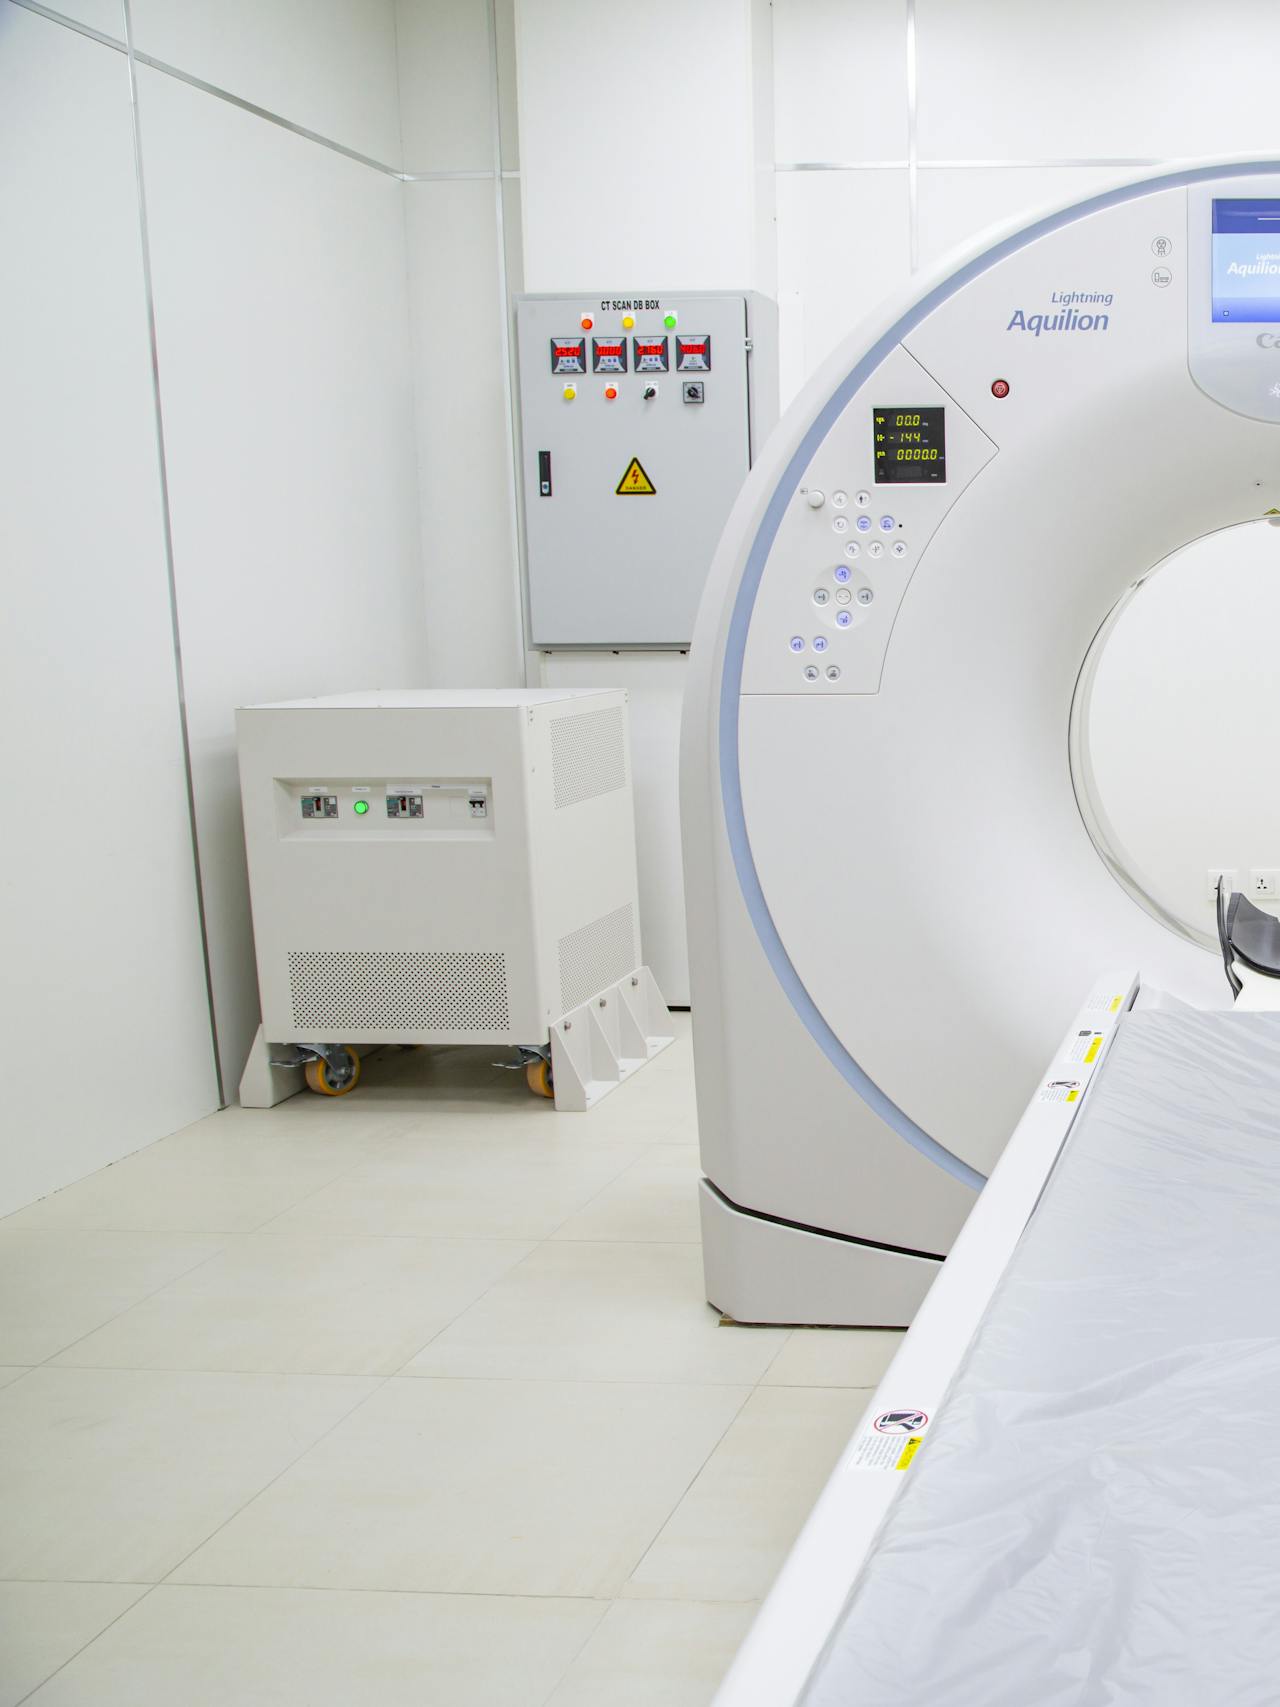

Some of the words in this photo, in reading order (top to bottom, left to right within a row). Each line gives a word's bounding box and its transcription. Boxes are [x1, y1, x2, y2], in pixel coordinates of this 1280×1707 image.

[1051, 291, 1113, 306] Lightning
[601, 301, 610, 310] CT
[612, 301, 631, 310] SCAN
[633, 300, 643, 310] DB
[645, 300, 659, 310] BOX
[1006, 309, 1109, 337] Aquilion
[896, 415, 920, 426] 00.0
[897, 449, 938, 460] 0000.0
